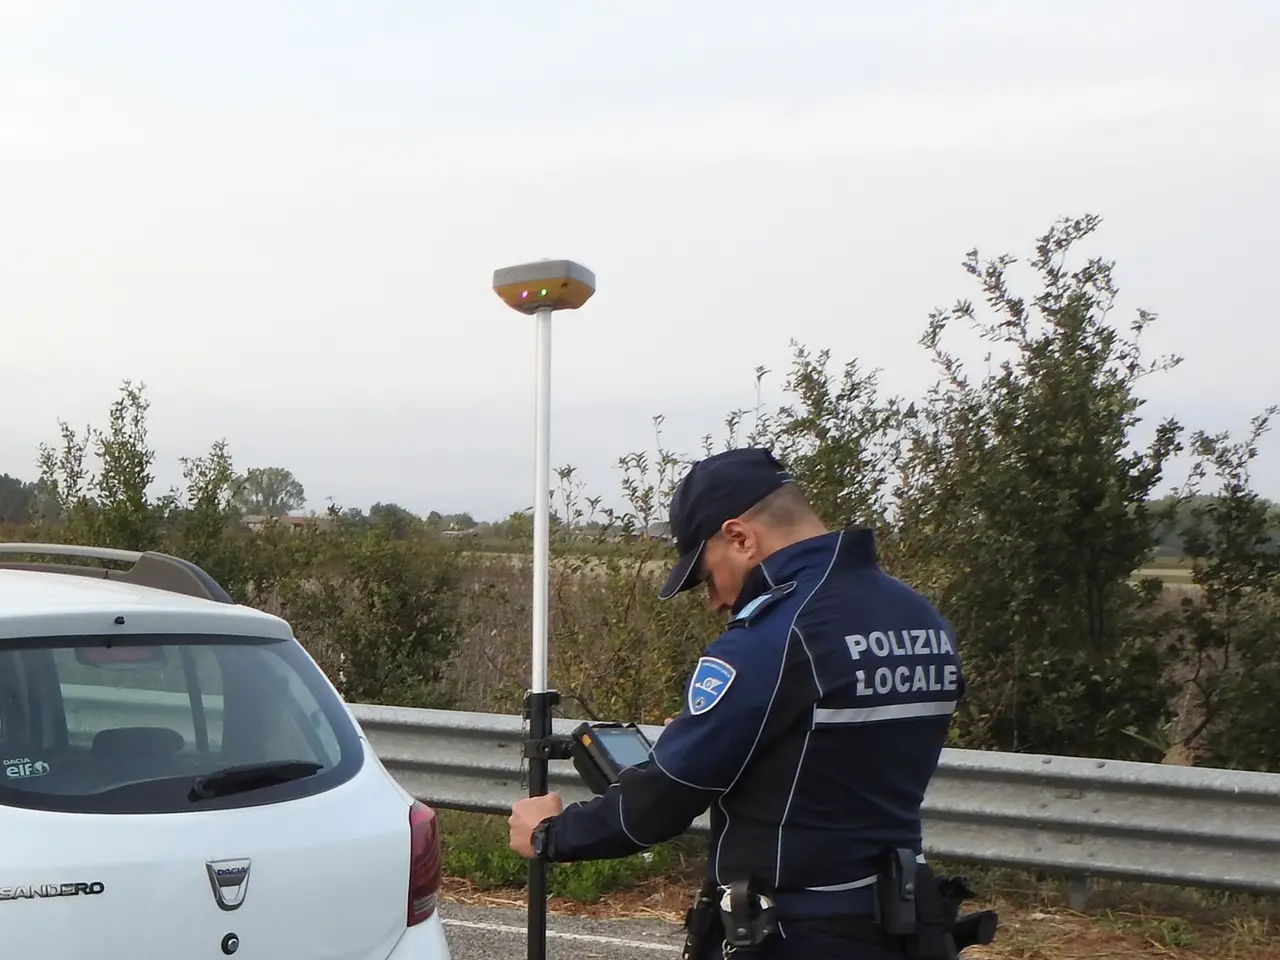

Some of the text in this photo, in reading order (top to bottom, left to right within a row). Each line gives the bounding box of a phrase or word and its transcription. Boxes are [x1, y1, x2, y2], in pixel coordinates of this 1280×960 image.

[844, 629, 954, 660] POLIZIA
[856, 665, 958, 696] LOCALE
[3, 757, 31, 766] DACIA
[6, 763, 33, 777] elf
[217, 867, 246, 876] DACIA
